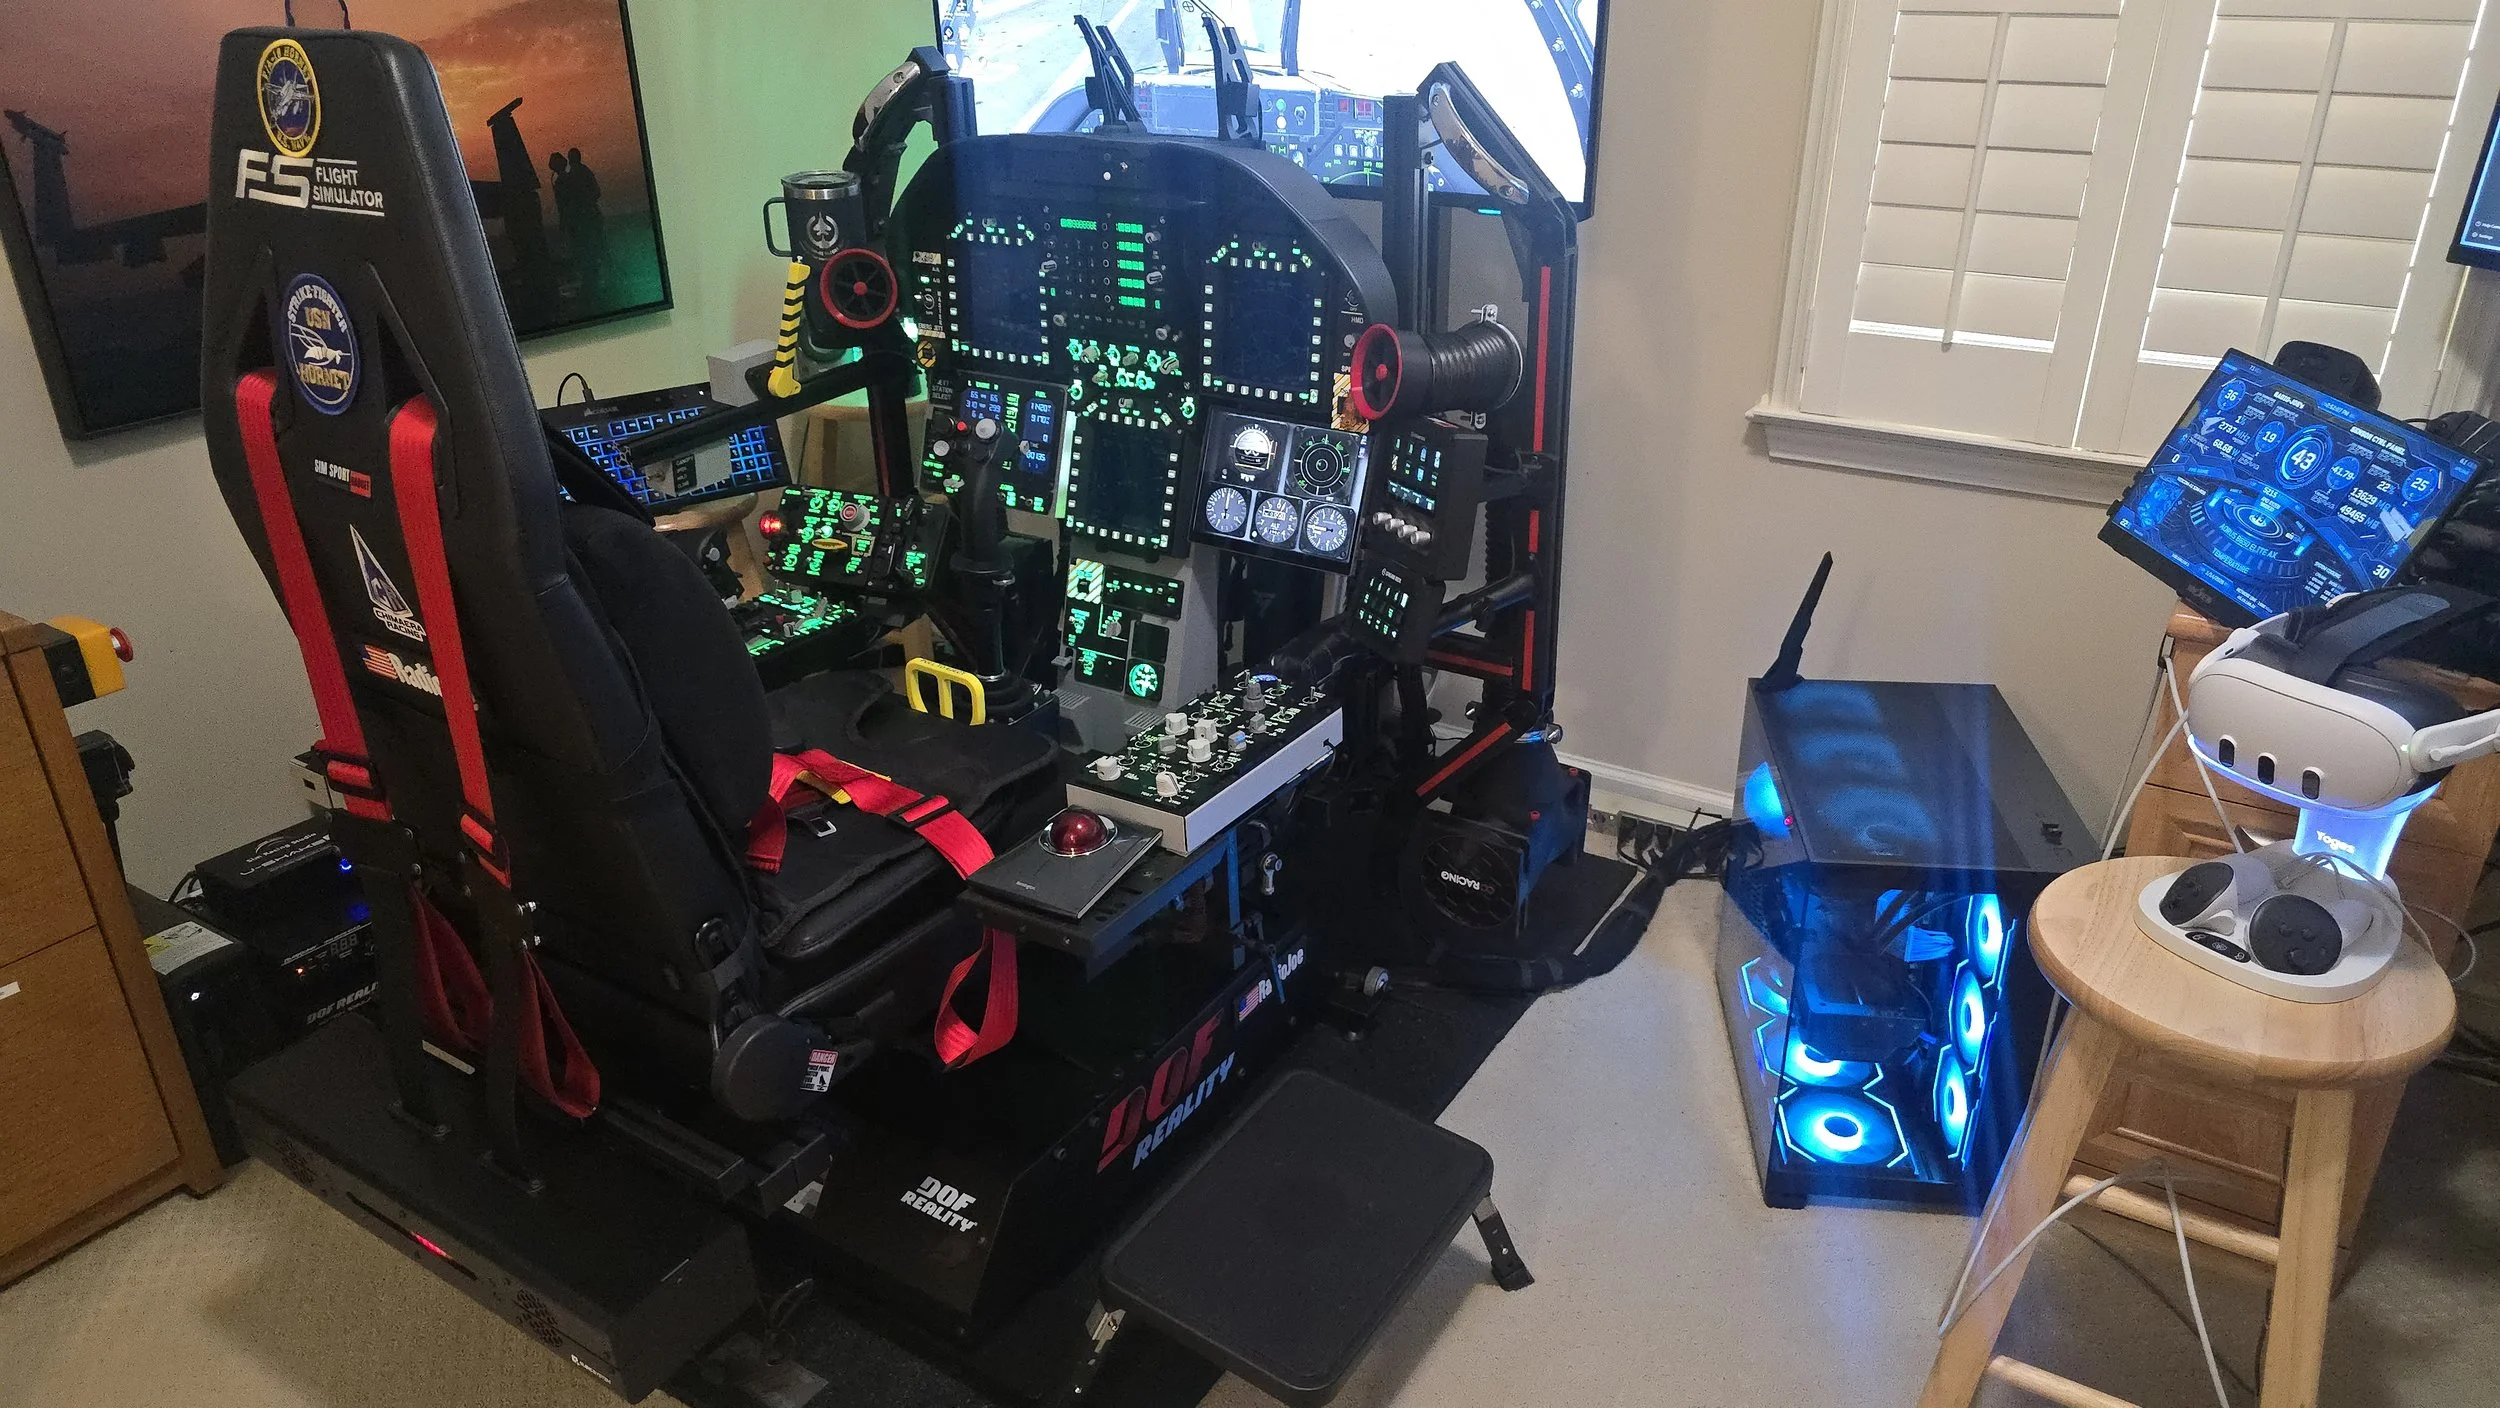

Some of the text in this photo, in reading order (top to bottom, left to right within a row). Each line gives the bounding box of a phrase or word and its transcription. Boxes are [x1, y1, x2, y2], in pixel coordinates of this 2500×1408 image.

[316, 167, 358, 185] FLIGHT
[313, 186, 384, 208] SIMULATOR
[304, 306, 332, 331] USN
[1351, 316, 1364, 324] HMD
[299, 361, 350, 391] HORNET
[2224, 389, 2238, 401] 36
[2218, 421, 2237, 434] 2737
[2262, 431, 2277, 443] 19
[314, 458, 328, 476] SIM
[329, 463, 350, 483] SPORT
[2291, 449, 2317, 471] 43
[2410, 478, 2430, 492] 25
[2350, 488, 2378, 506] 13629
[2340, 504, 2380, 530] 49465 MB
[2212, 546, 2250, 575] TEMPERATURE
[2268, 550, 2278, 560] AX
[2372, 564, 2390, 580] 30
[375, 610, 424, 632] CHIMAERA
[386, 620, 422, 638] RACING
[1440, 870, 1480, 890] RACING
[810, 1051, 836, 1064] DANGER
[1096, 1008, 1226, 1175] DOF
[1132, 1050, 1236, 1170] REALITY
[917, 1176, 976, 1212] DOF
[900, 1190, 976, 1233] REALITY
